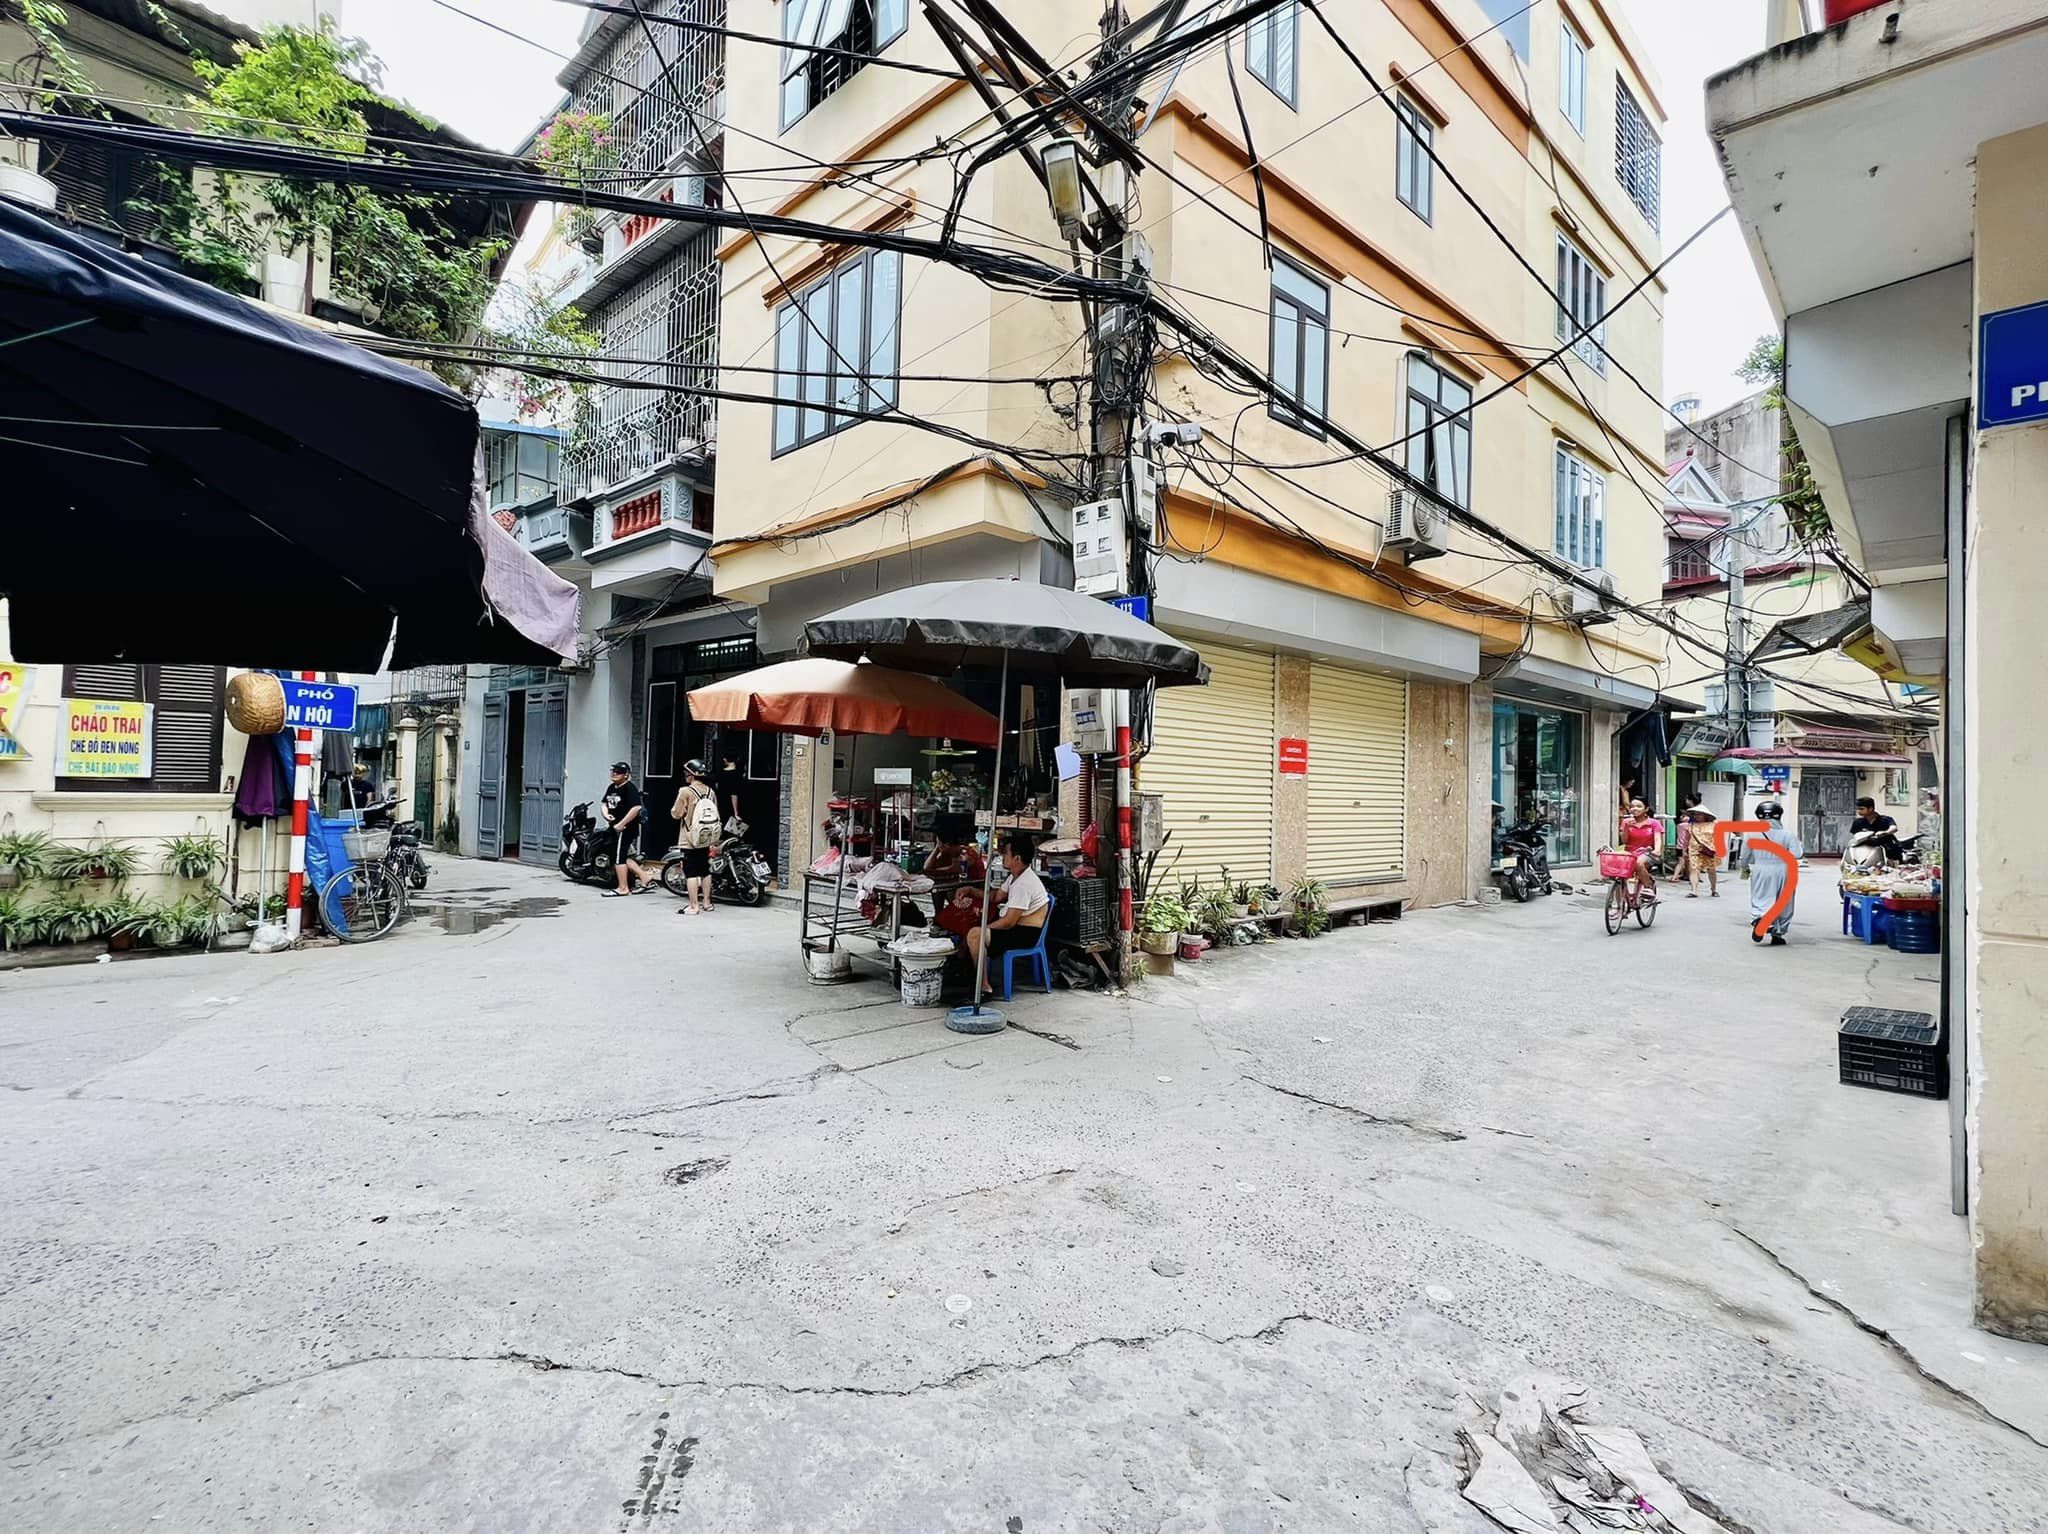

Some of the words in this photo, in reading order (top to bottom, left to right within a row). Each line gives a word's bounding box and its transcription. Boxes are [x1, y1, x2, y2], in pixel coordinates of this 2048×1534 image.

[297, 688, 334, 700] PHỐ
[305, 705, 332, 726] HỘI
[112, 716, 142, 734] TRAI
